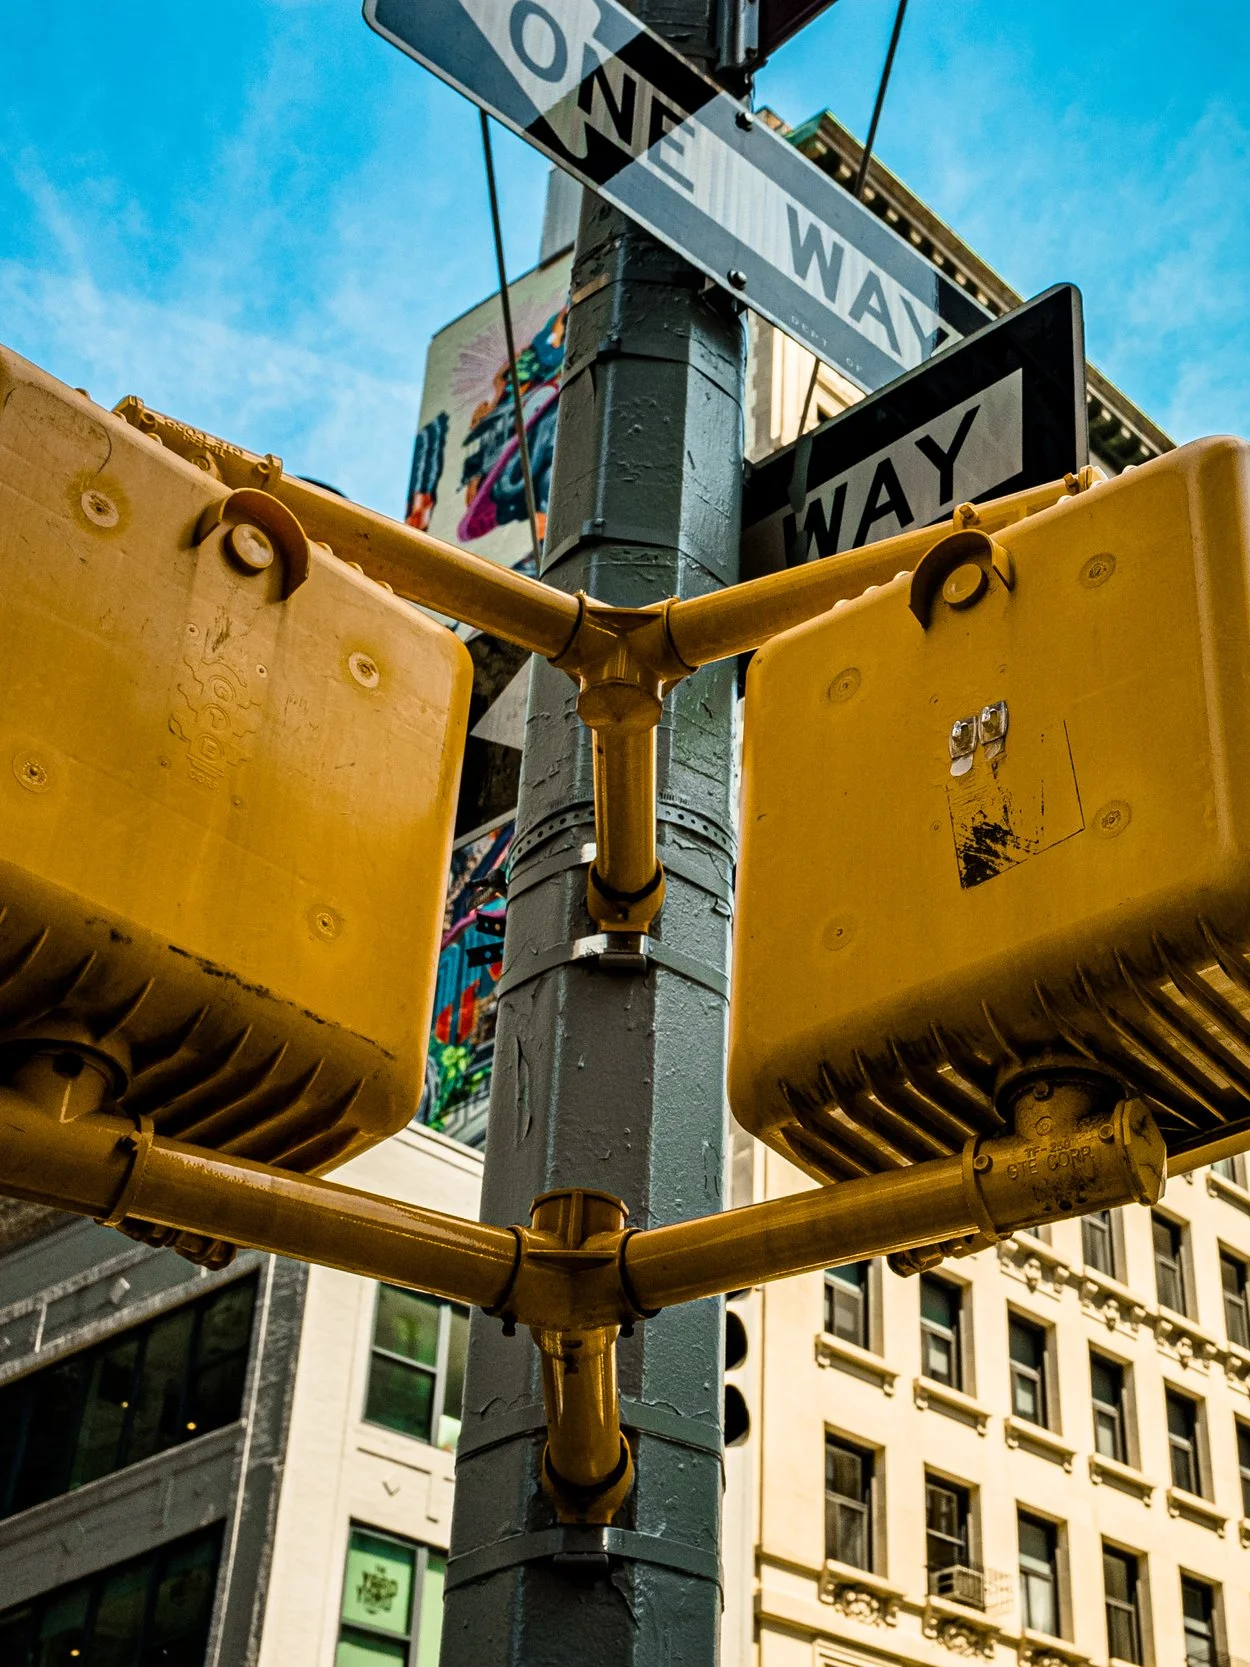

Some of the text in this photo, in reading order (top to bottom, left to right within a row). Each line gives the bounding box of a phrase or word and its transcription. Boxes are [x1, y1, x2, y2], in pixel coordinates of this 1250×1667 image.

[510, 0, 951, 363] ONE WAY
[782, 403, 981, 570] WAY
[1006, 1156, 1039, 1180] GTE
